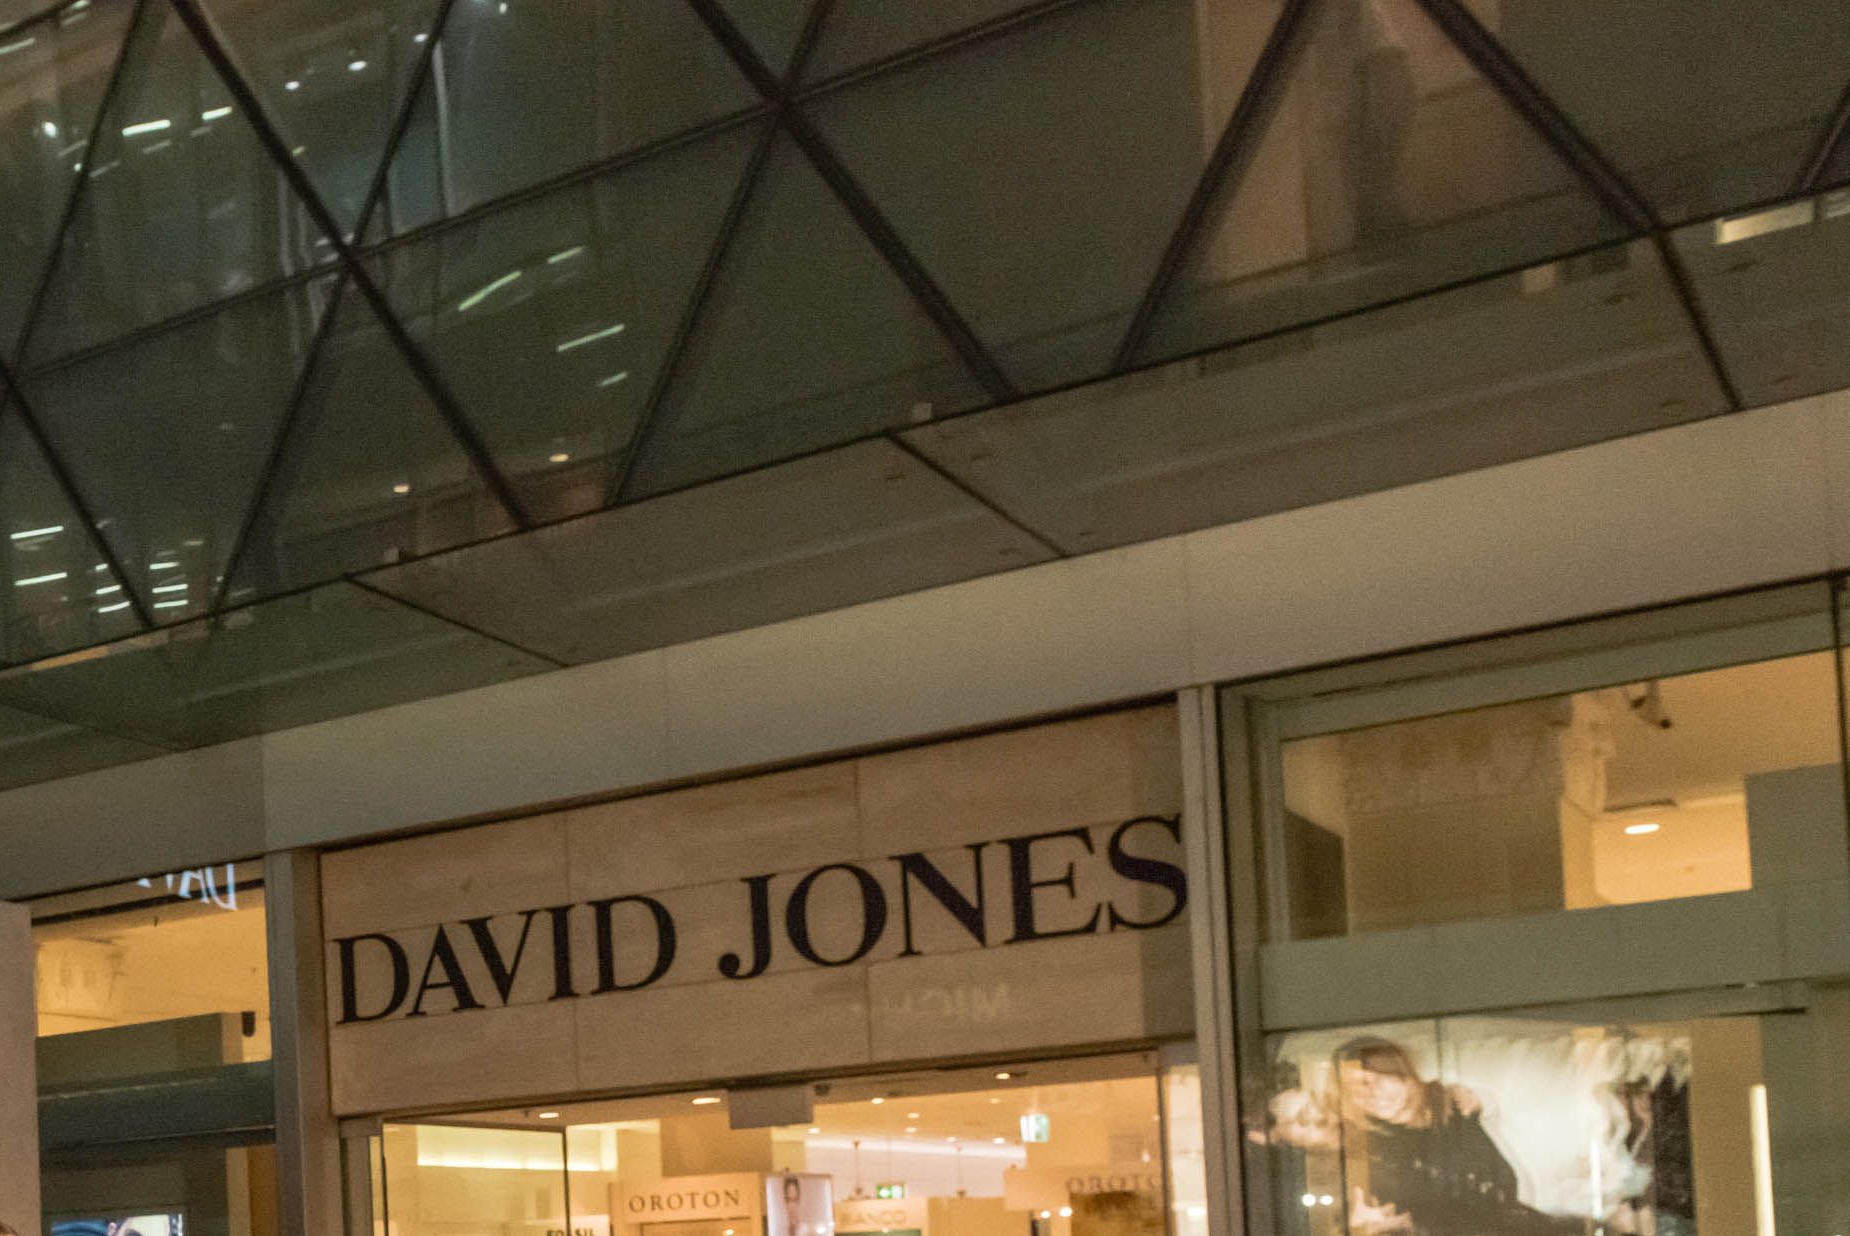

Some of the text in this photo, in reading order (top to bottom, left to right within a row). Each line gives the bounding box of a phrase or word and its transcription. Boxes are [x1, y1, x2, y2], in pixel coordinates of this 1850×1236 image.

[331, 813, 1190, 1025] DAVID JONES
[627, 1189, 742, 1213] OROTON
